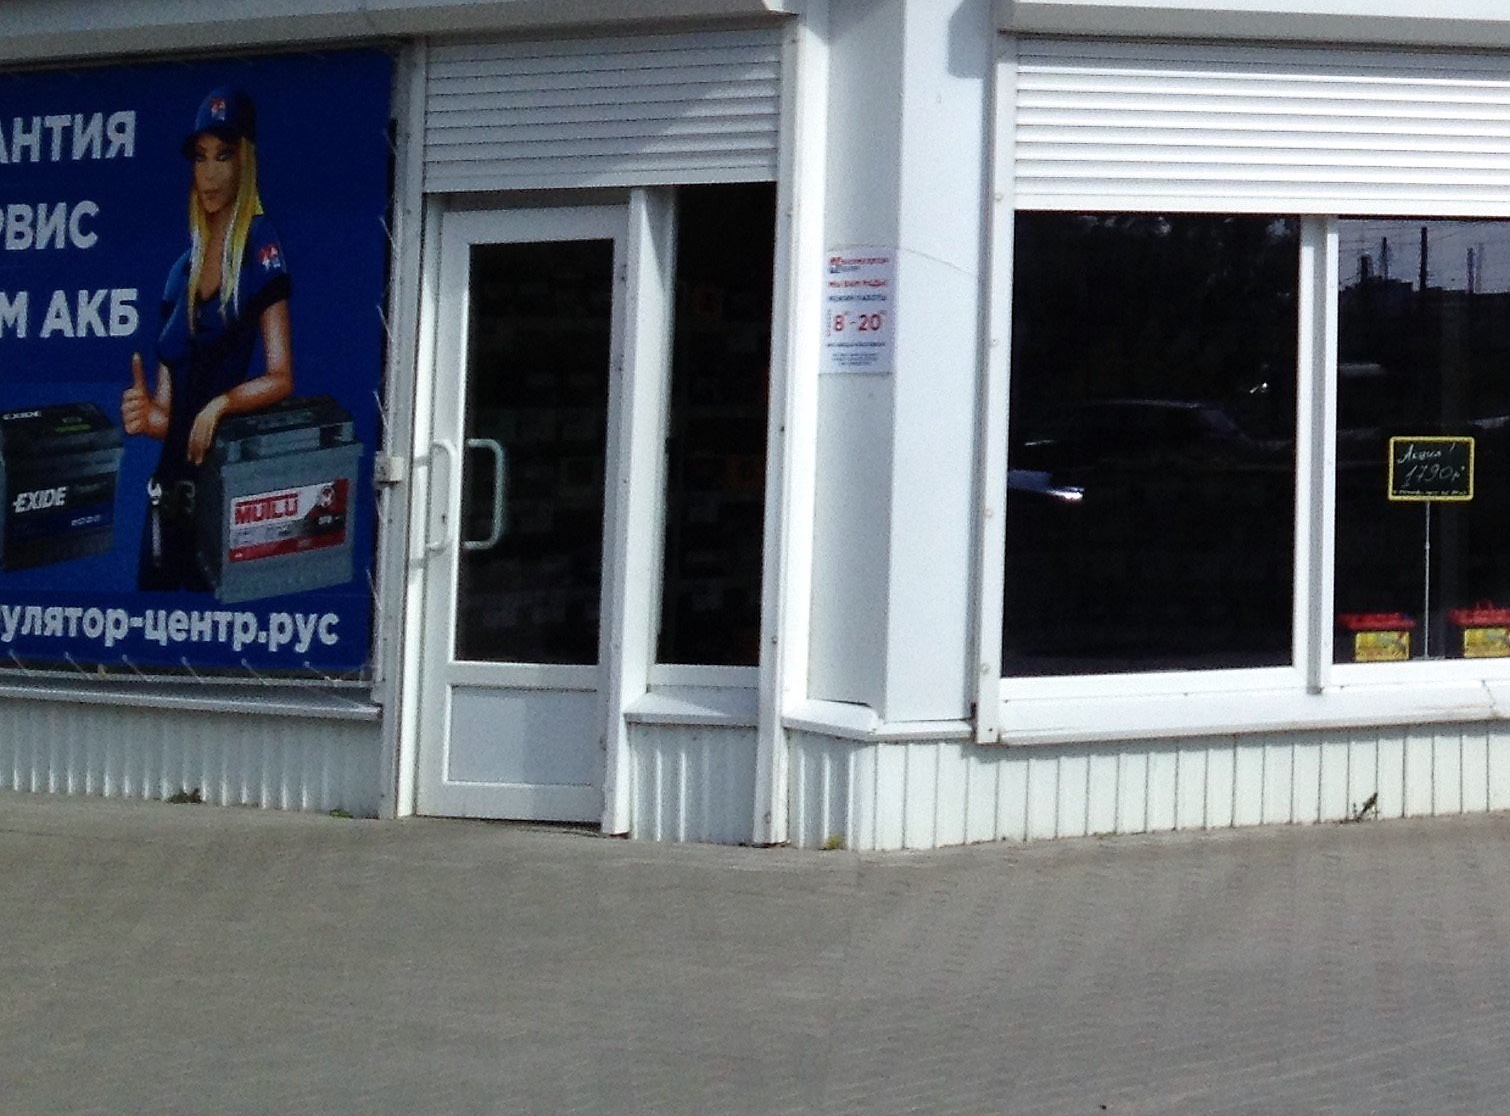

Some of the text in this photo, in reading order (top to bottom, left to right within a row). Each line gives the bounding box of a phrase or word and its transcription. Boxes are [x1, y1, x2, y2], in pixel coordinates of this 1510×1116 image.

[0, 110, 136, 164] НТИЯ
[0, 200, 99, 251] ВИС
[40, 288, 139, 338] АКБ
[13, 486, 67, 513] EXIDE
[0, 605, 340, 653] улятор-центр.рус
